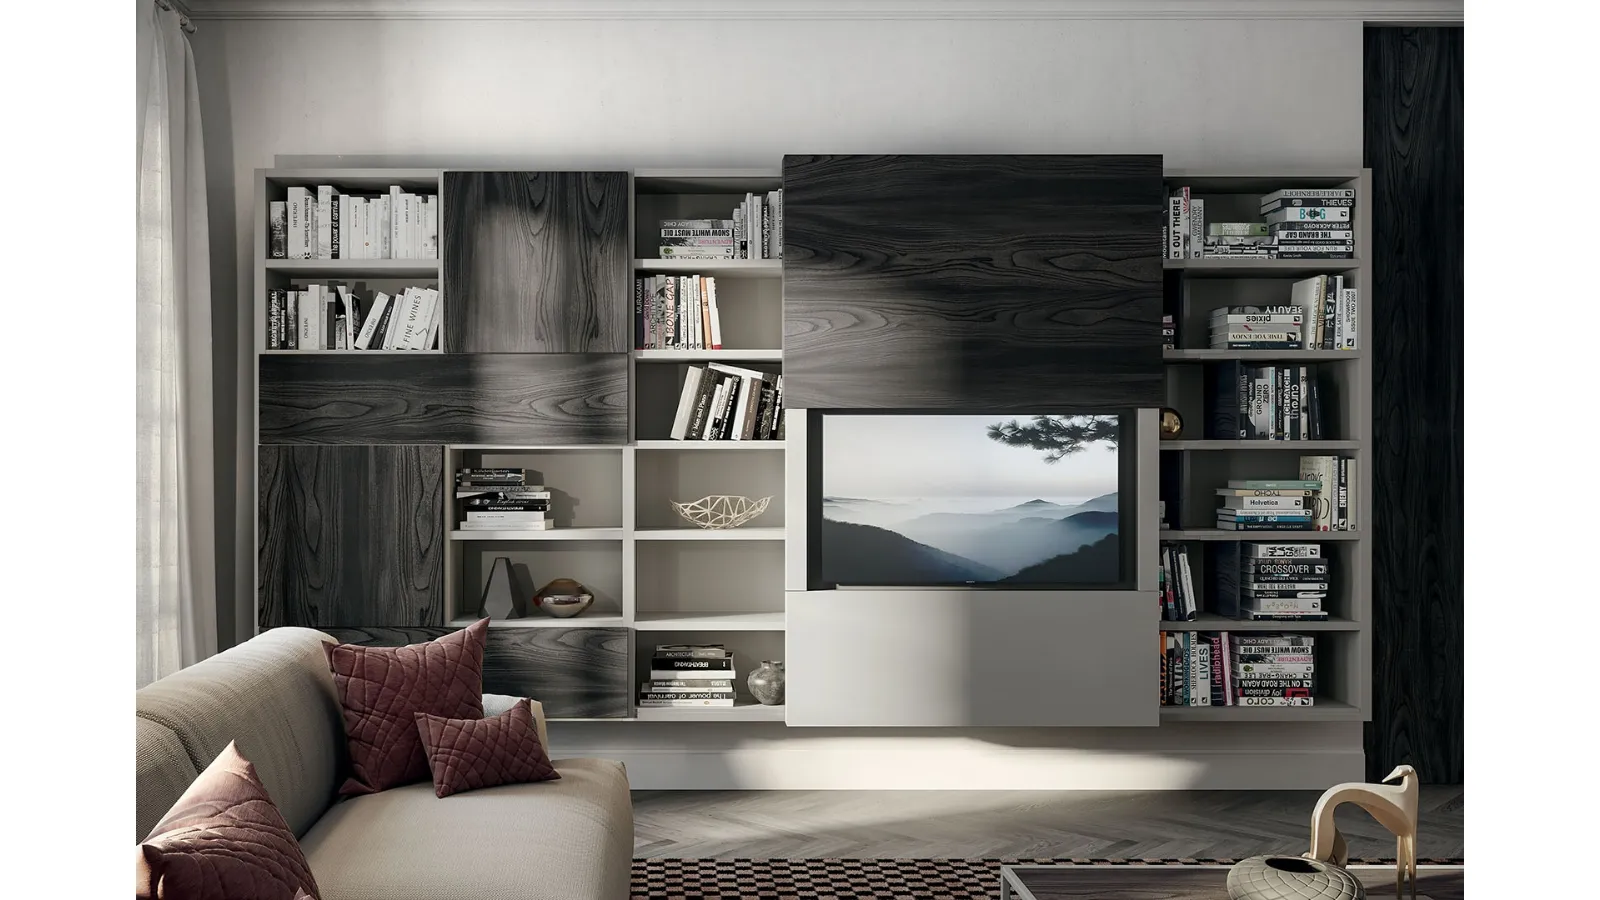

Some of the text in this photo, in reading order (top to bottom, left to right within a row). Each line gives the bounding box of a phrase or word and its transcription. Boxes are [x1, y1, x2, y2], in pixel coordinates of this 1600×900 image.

[665, 279, 674, 335] BONE GAP
[403, 295, 422, 343] FINE WINES
[1246, 314, 1271, 324] pixies
[1260, 564, 1310, 573] CROSSOVER
[1199, 648, 1209, 680] LIVES
[688, 691, 711, 699] power
